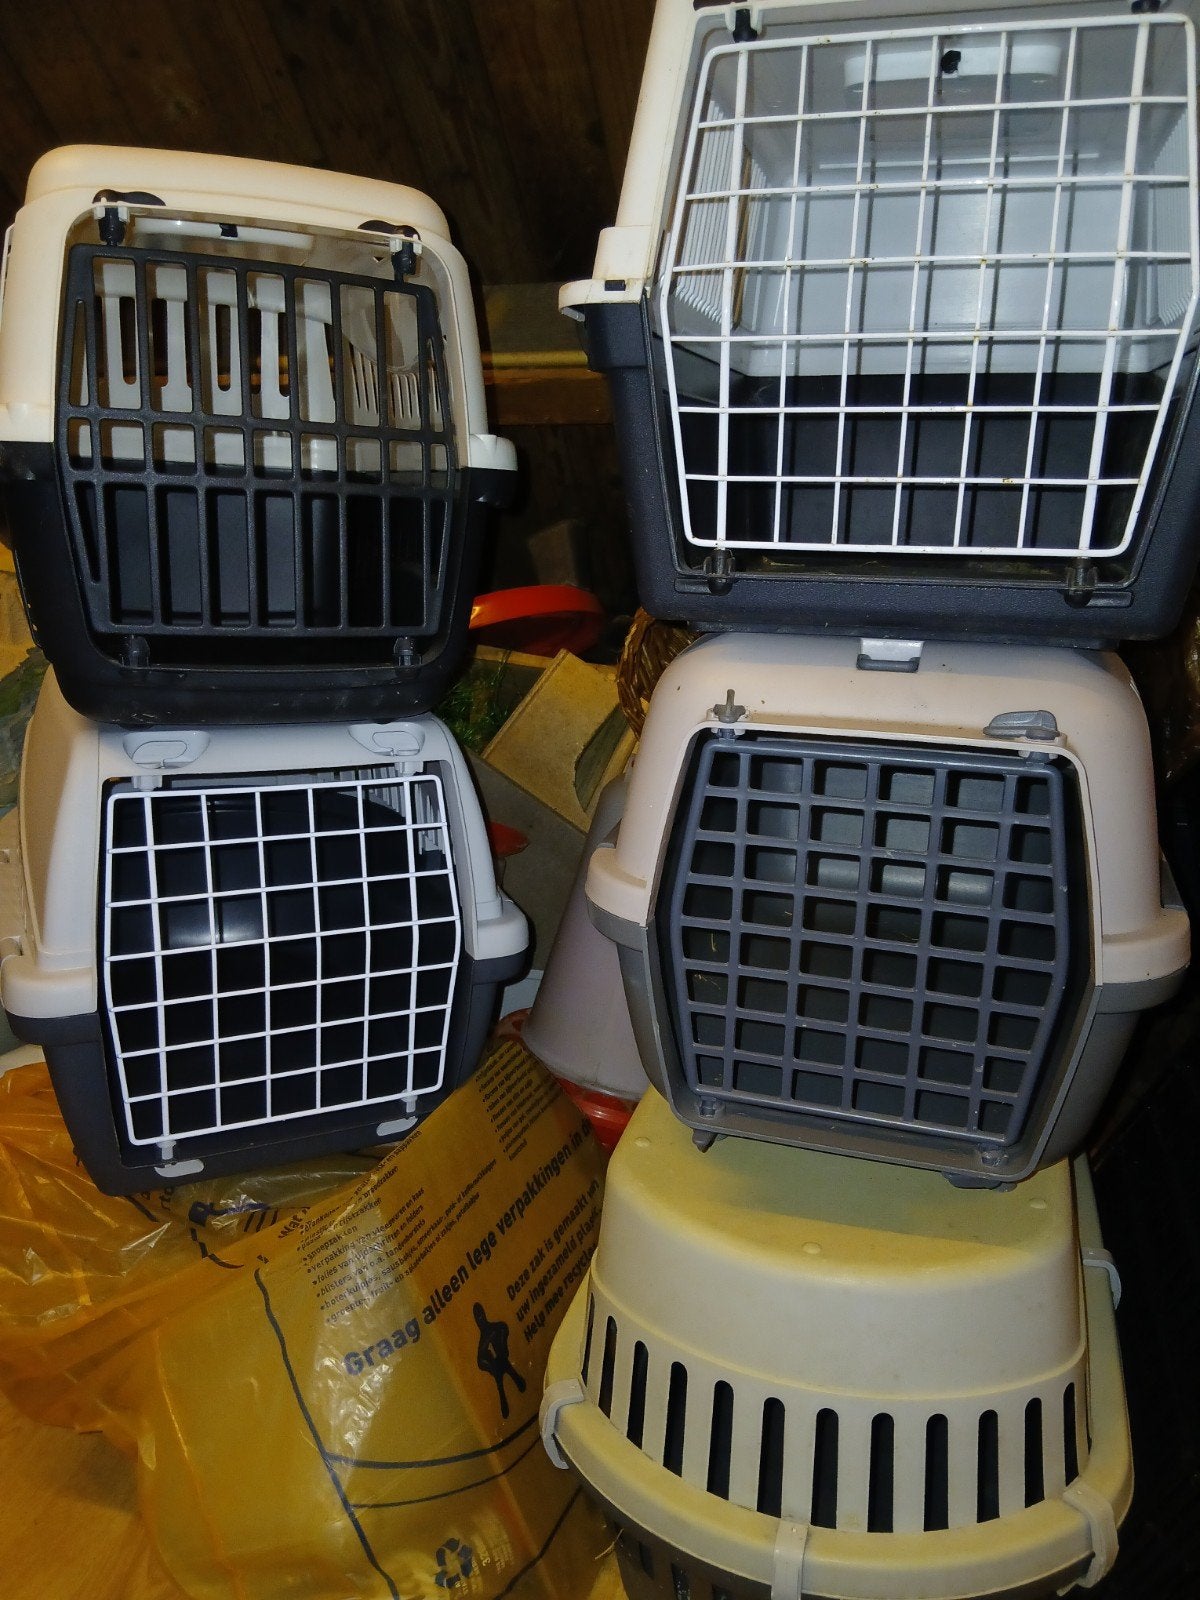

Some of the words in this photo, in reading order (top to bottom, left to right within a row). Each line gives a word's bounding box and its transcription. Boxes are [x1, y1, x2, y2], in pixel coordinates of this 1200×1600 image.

[310, 1241, 355, 1270] verpakking
[344, 1317, 421, 1376] Graag
[422, 1265, 470, 1324] alleen
[465, 1231, 498, 1271] lege
[495, 1143, 572, 1236] verpakkingen
[569, 1131, 583, 1150] in
[505, 1268, 531, 1300] Deze
[529, 1246, 546, 1272] zak
[542, 1237, 554, 1251] is
[552, 1195, 589, 1243] gemaakt
[516, 1299, 532, 1321] uw
[527, 1236, 578, 1302] ingezameld
[523, 1310, 546, 1342] Help
[544, 1285, 564, 1313] mee
